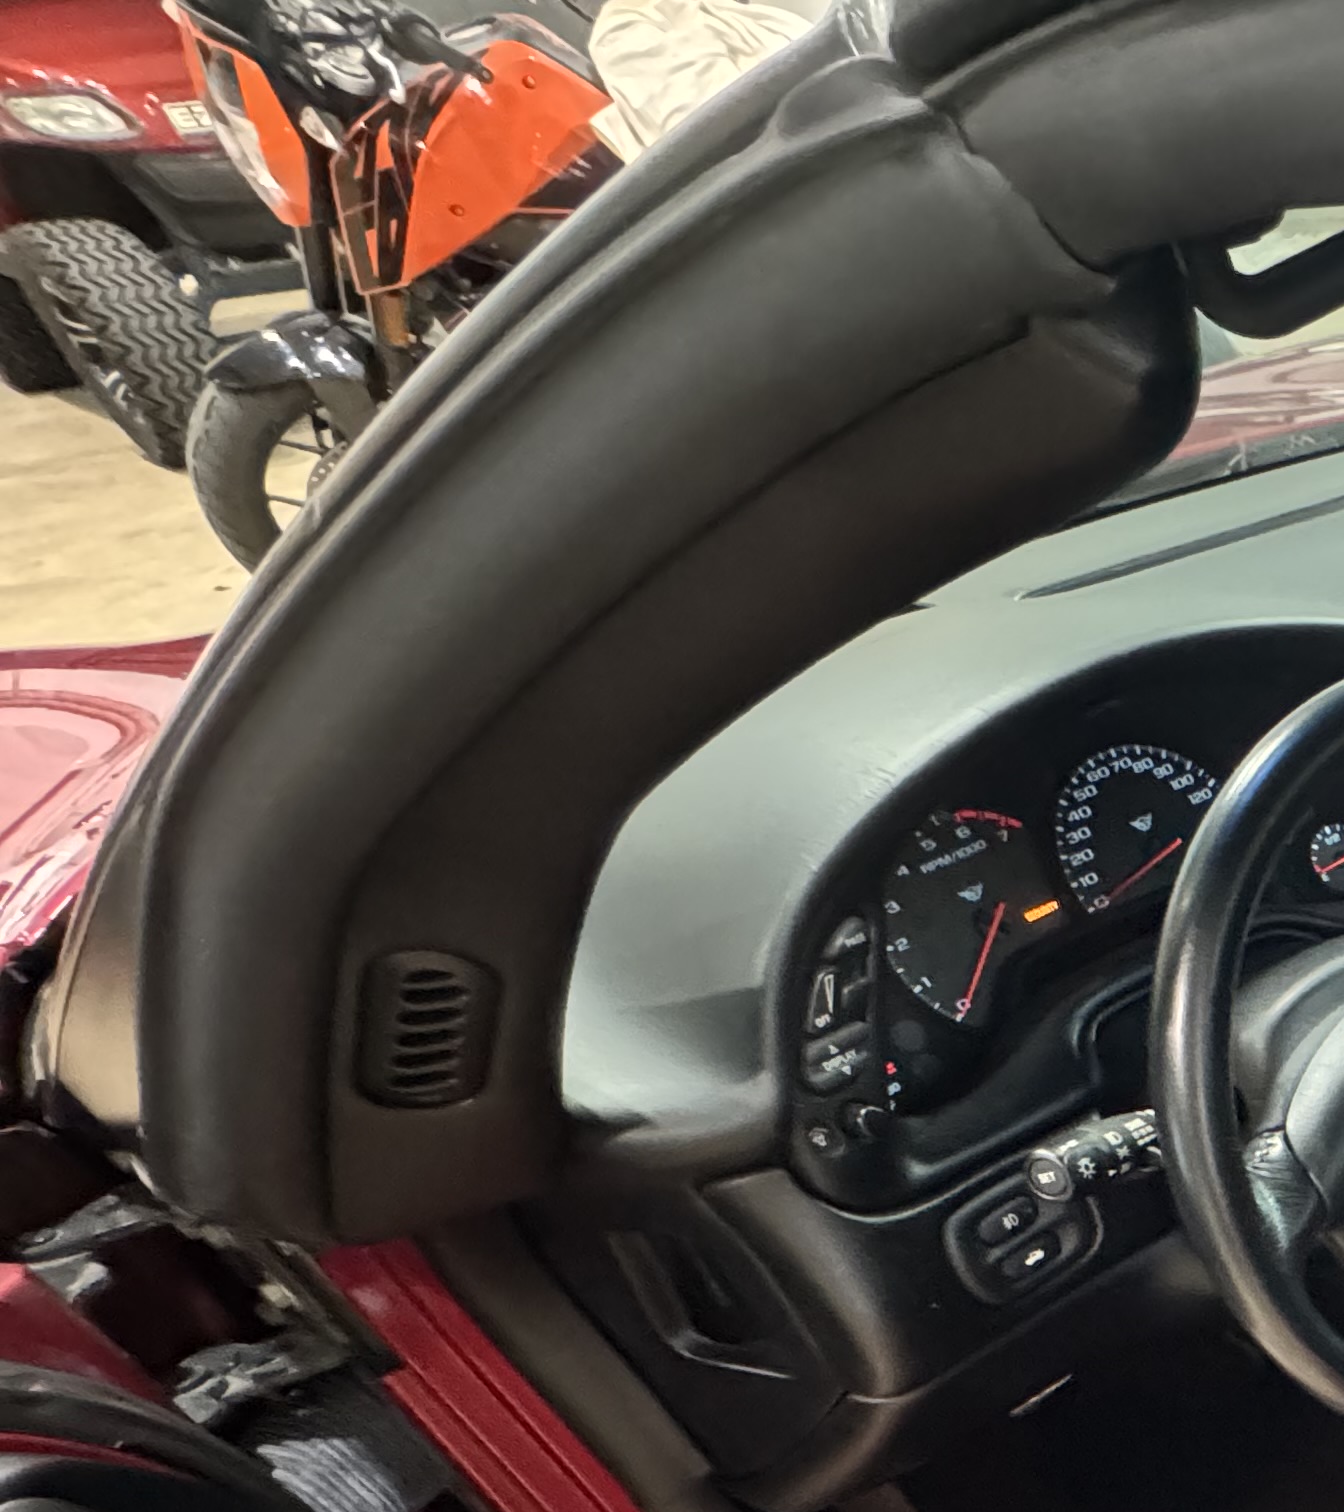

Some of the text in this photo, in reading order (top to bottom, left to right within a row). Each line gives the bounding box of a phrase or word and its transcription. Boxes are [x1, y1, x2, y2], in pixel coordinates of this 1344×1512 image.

[1109, 756, 1133, 773] 70
[1132, 757, 1154, 774] 80
[1152, 763, 1174, 780] 90
[1086, 766, 1111, 782] 60
[1169, 773, 1195, 791] 100
[1072, 784, 1099, 801] 50
[1187, 787, 1213, 805] 120
[1067, 805, 1093, 822] 40
[1065, 826, 1092, 845] 30
[1069, 848, 1095, 867] 20
[1078, 871, 1099, 888] 10
[894, 937, 911, 952] 2
